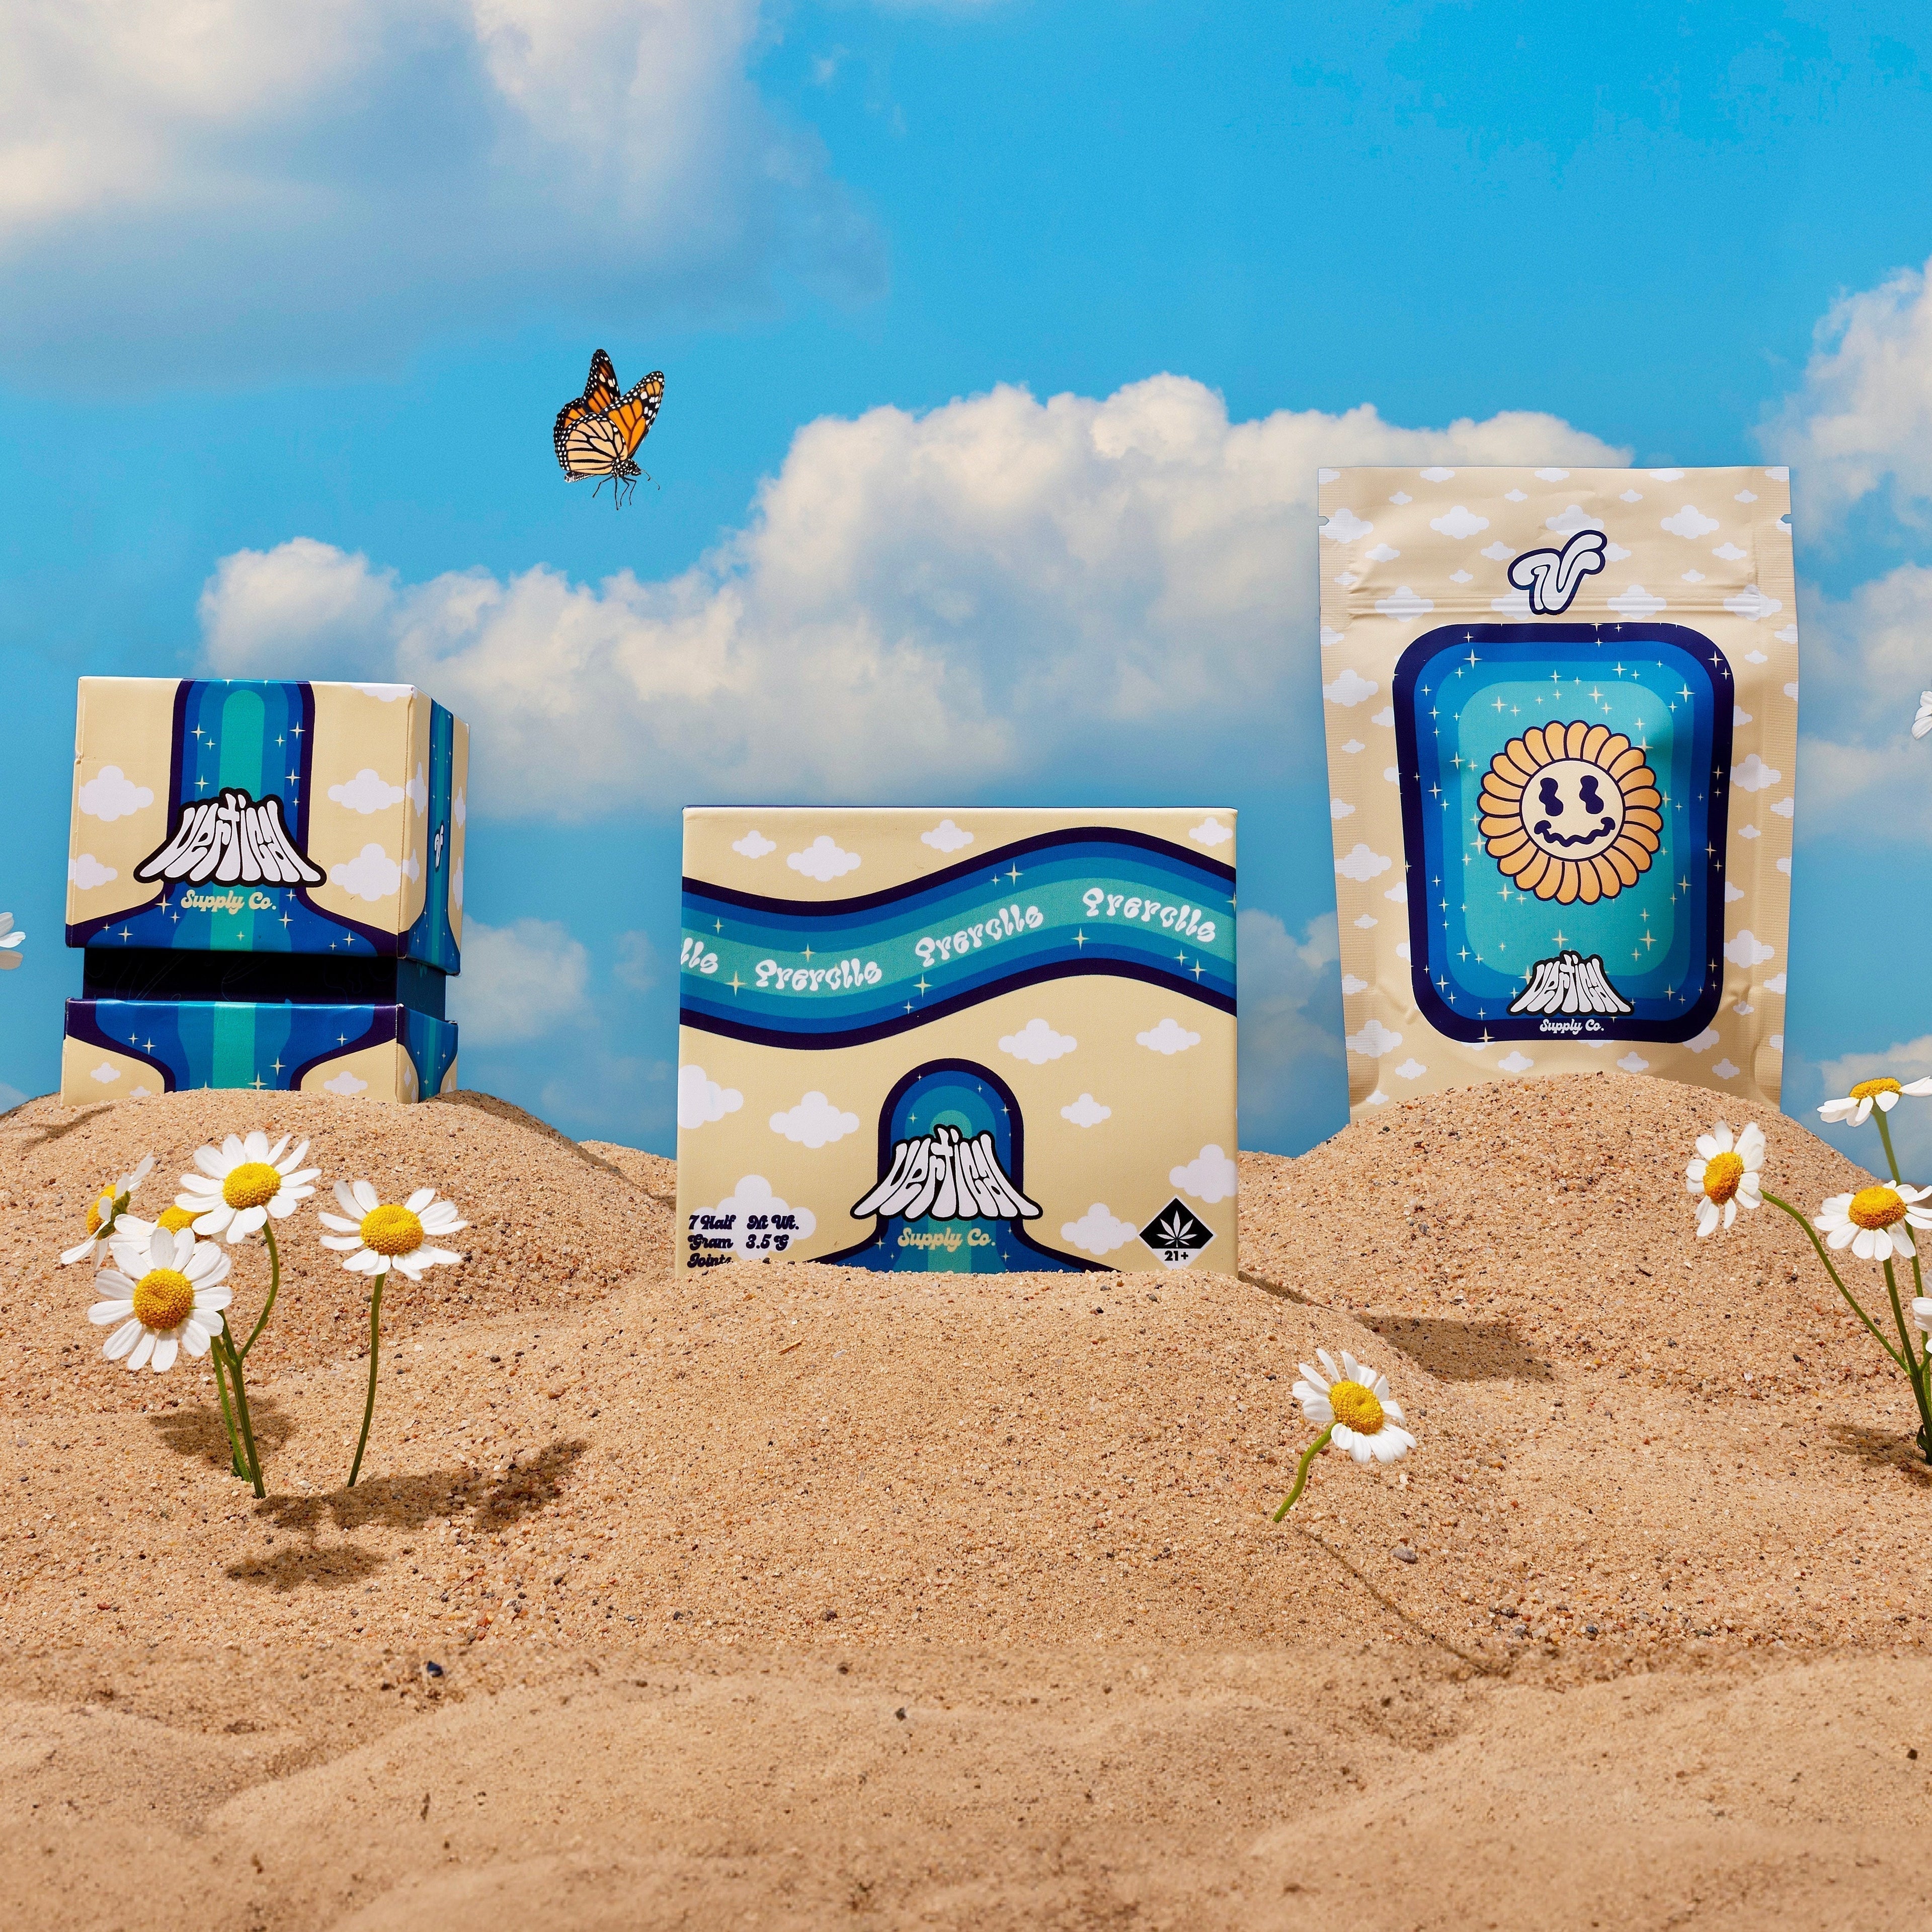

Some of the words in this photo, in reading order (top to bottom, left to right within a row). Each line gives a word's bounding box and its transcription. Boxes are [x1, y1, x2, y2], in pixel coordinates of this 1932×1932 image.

[180, 889, 245, 915] Supply
[249, 891, 277, 910] Co.
[1083, 887, 1216, 943] Prerolls
[914, 904, 1043, 968] Prerolls
[755, 957, 882, 992] Prerolls
[1539, 1018, 1583, 1035] Supply
[1585, 1018, 1604, 1031] Co.
[688, 1214, 700, 1230] 7
[700, 1214, 737, 1230] Half
[771, 1214, 799, 1230] Wt.
[687, 1233, 734, 1251] Gram
[746, 1234, 772, 1249] 3.5
[773, 1234, 789, 1251] G
[897, 1227, 963, 1253] Supply
[967, 1228, 997, 1247] Co.
[1164, 1250, 1189, 1261] 21+
